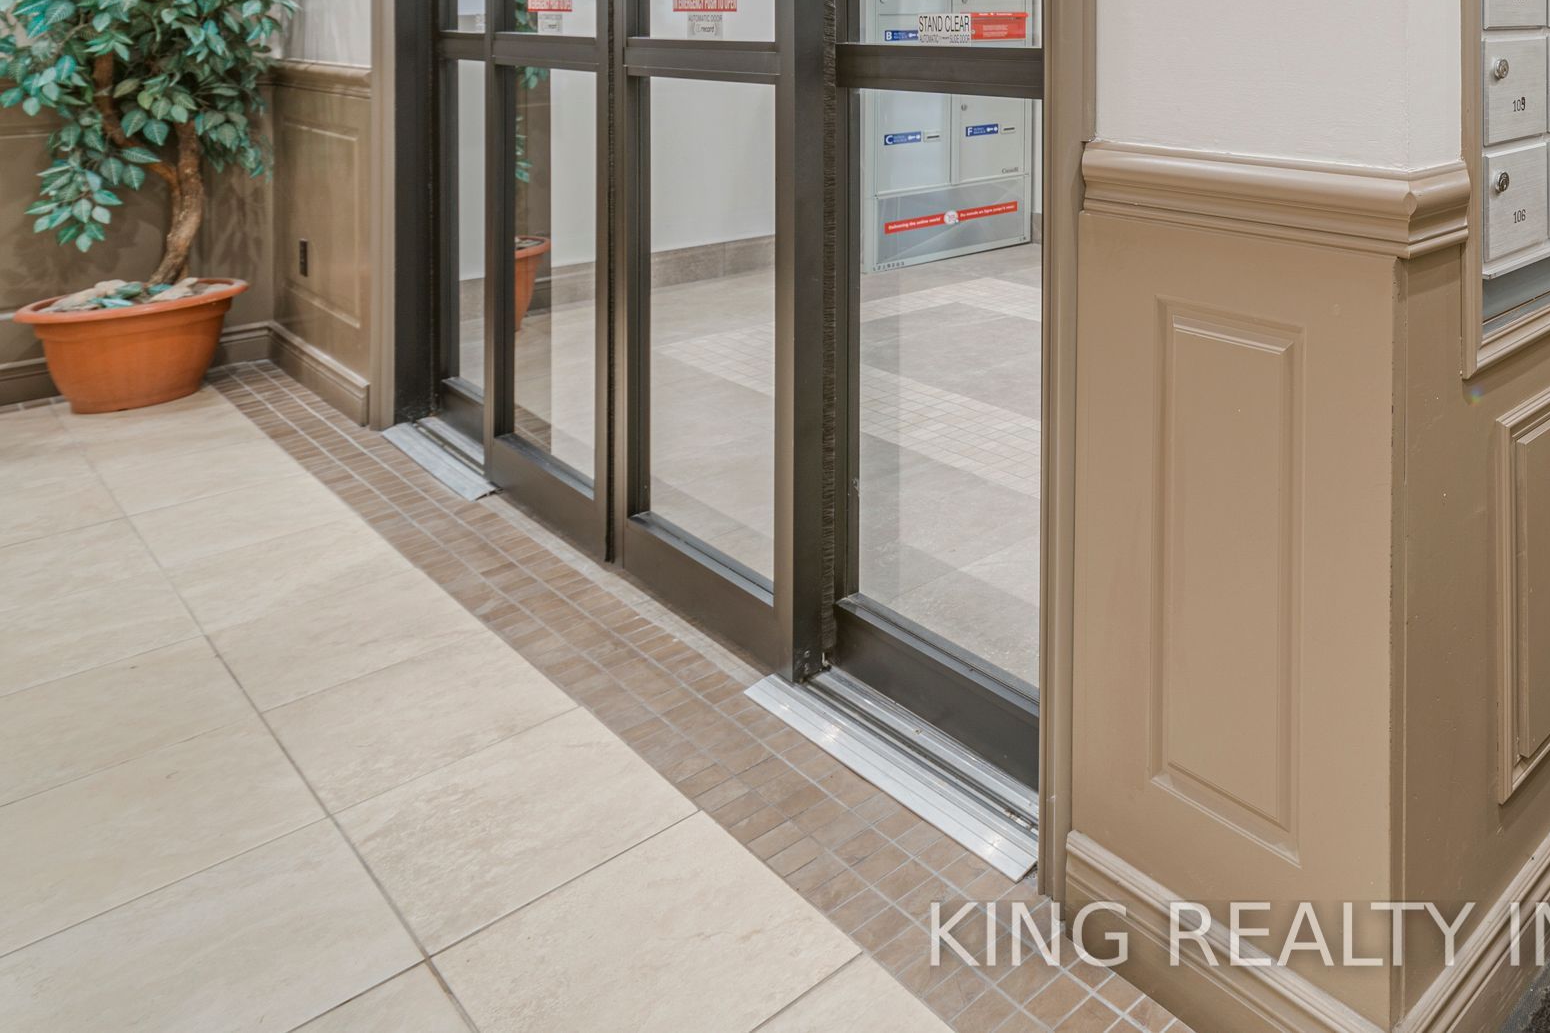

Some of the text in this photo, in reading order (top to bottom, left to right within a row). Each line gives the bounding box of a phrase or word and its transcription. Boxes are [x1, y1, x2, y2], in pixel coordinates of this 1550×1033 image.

[919, 15, 943, 33] STAND
[944, 15, 970, 33] CLEAR
[886, 31, 892, 41] B
[967, 127, 974, 136] F
[886, 135, 894, 145] C
[1513, 209, 1526, 224] 106
